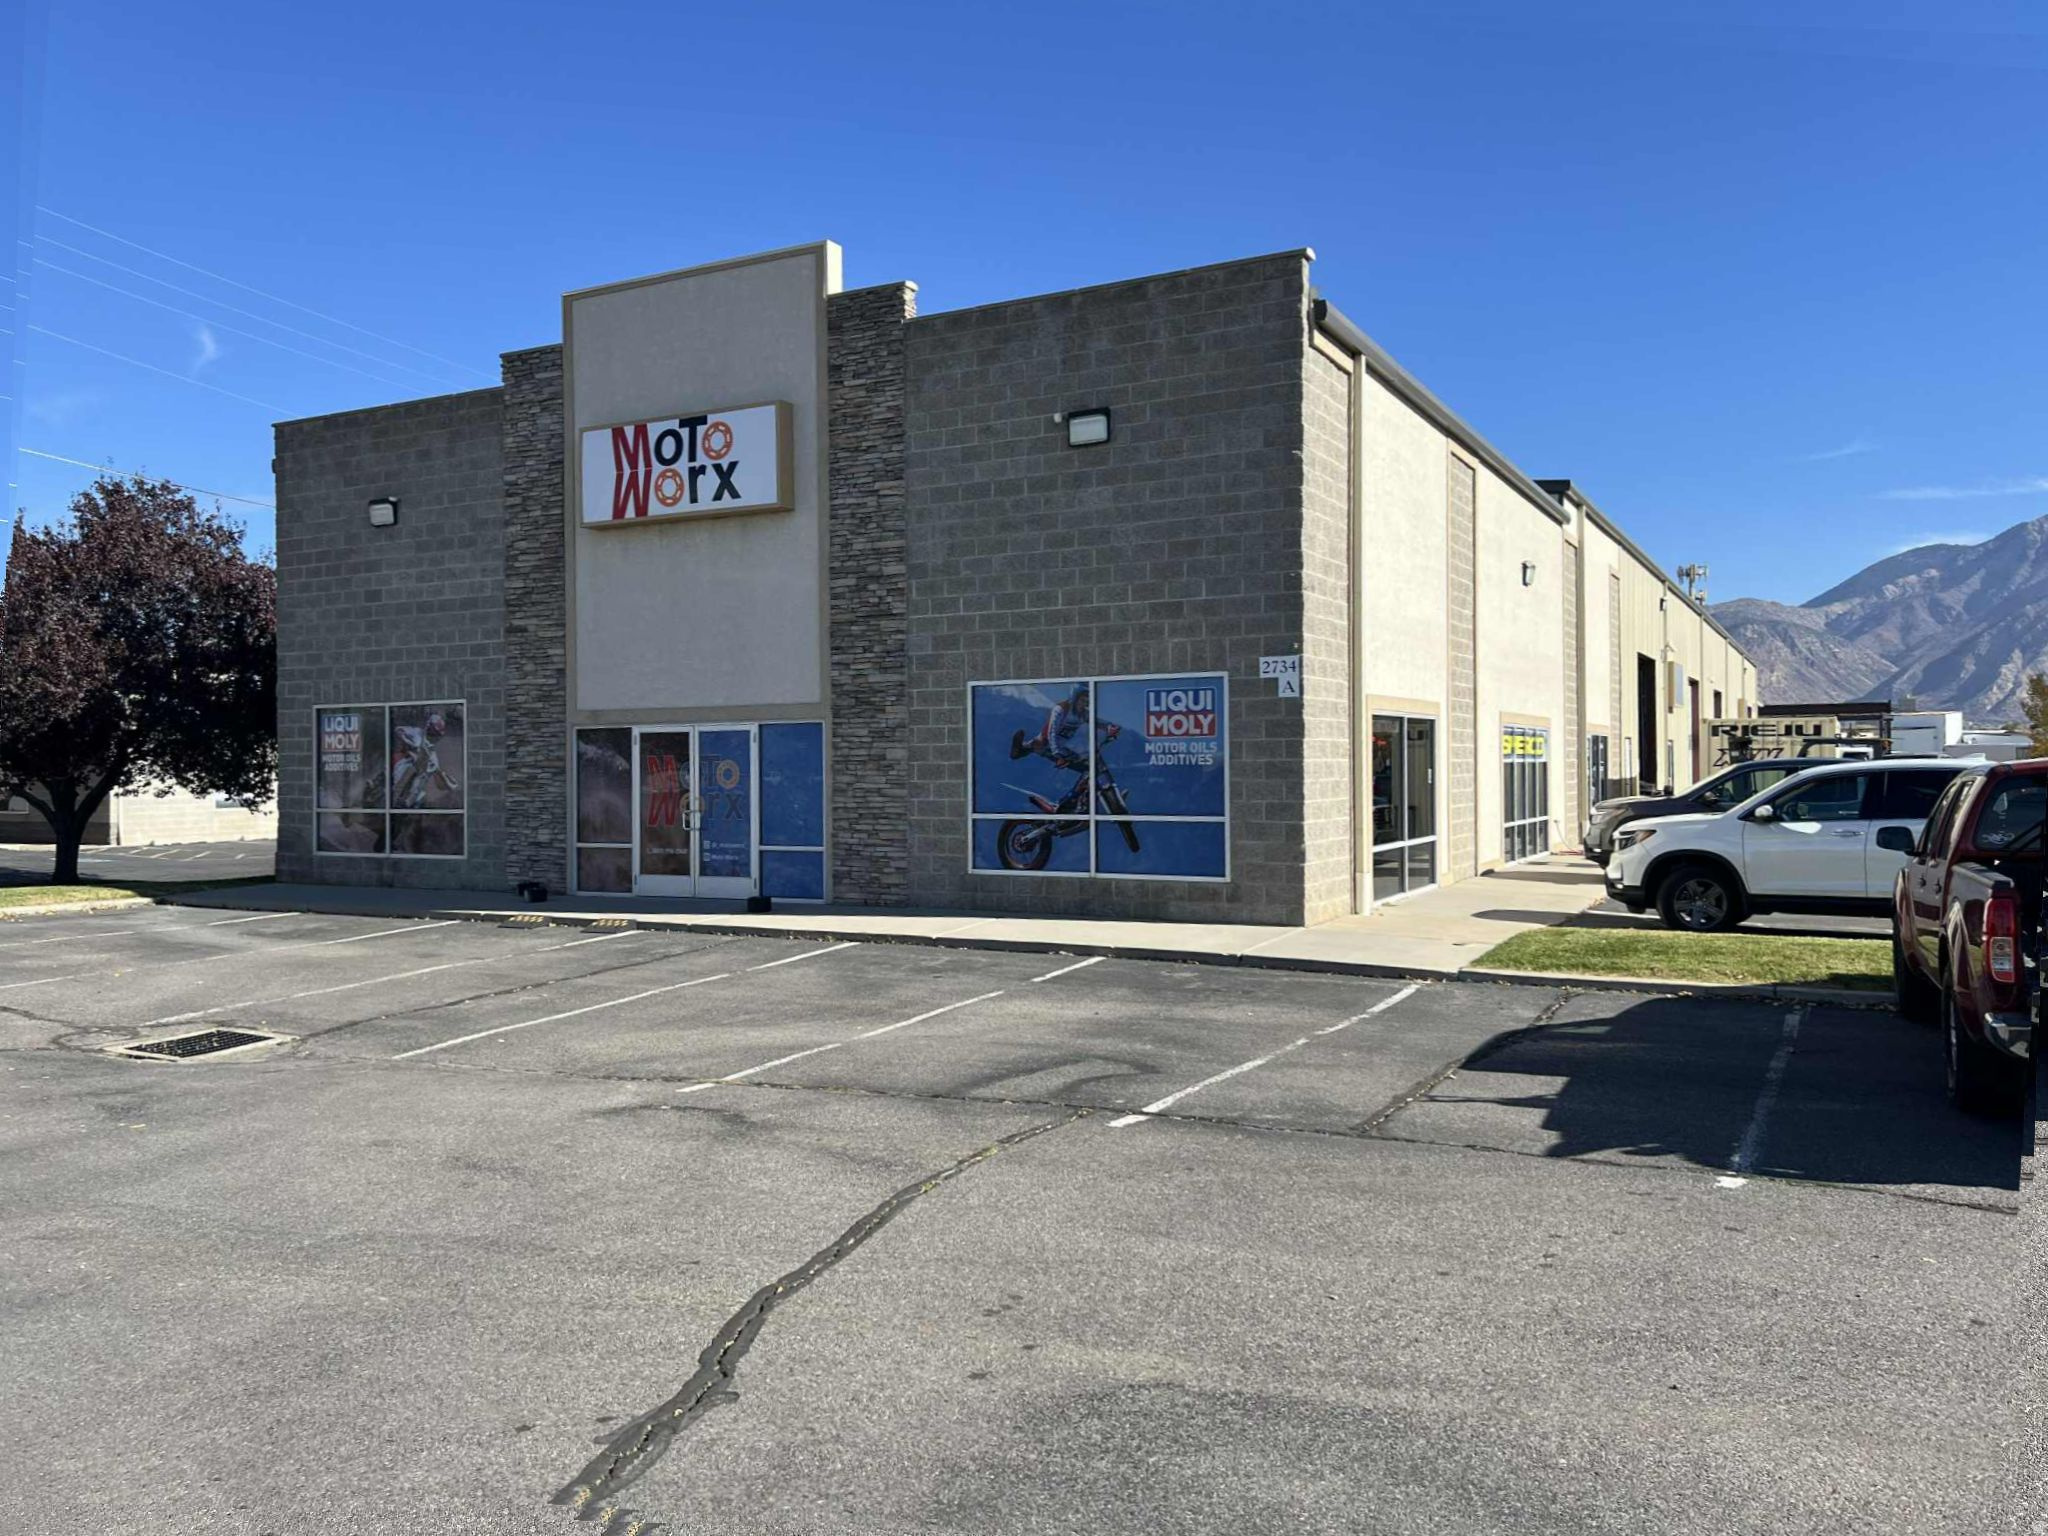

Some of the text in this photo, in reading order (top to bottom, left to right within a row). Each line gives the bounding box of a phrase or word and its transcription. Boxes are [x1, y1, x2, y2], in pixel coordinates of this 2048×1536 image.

[1262, 660, 1297, 674] 2734
[1282, 680, 1296, 693] A
[1149, 690, 1212, 712] LIQUI
[324, 716, 359, 732] LIQUI
[1149, 714, 1215, 735] MOLY
[1711, 724, 1822, 737] RIEJU
[324, 734, 359, 749] MOLY
[1145, 742, 1217, 753] MOTOR OILS
[1149, 754, 1214, 765] ADDITIVES
